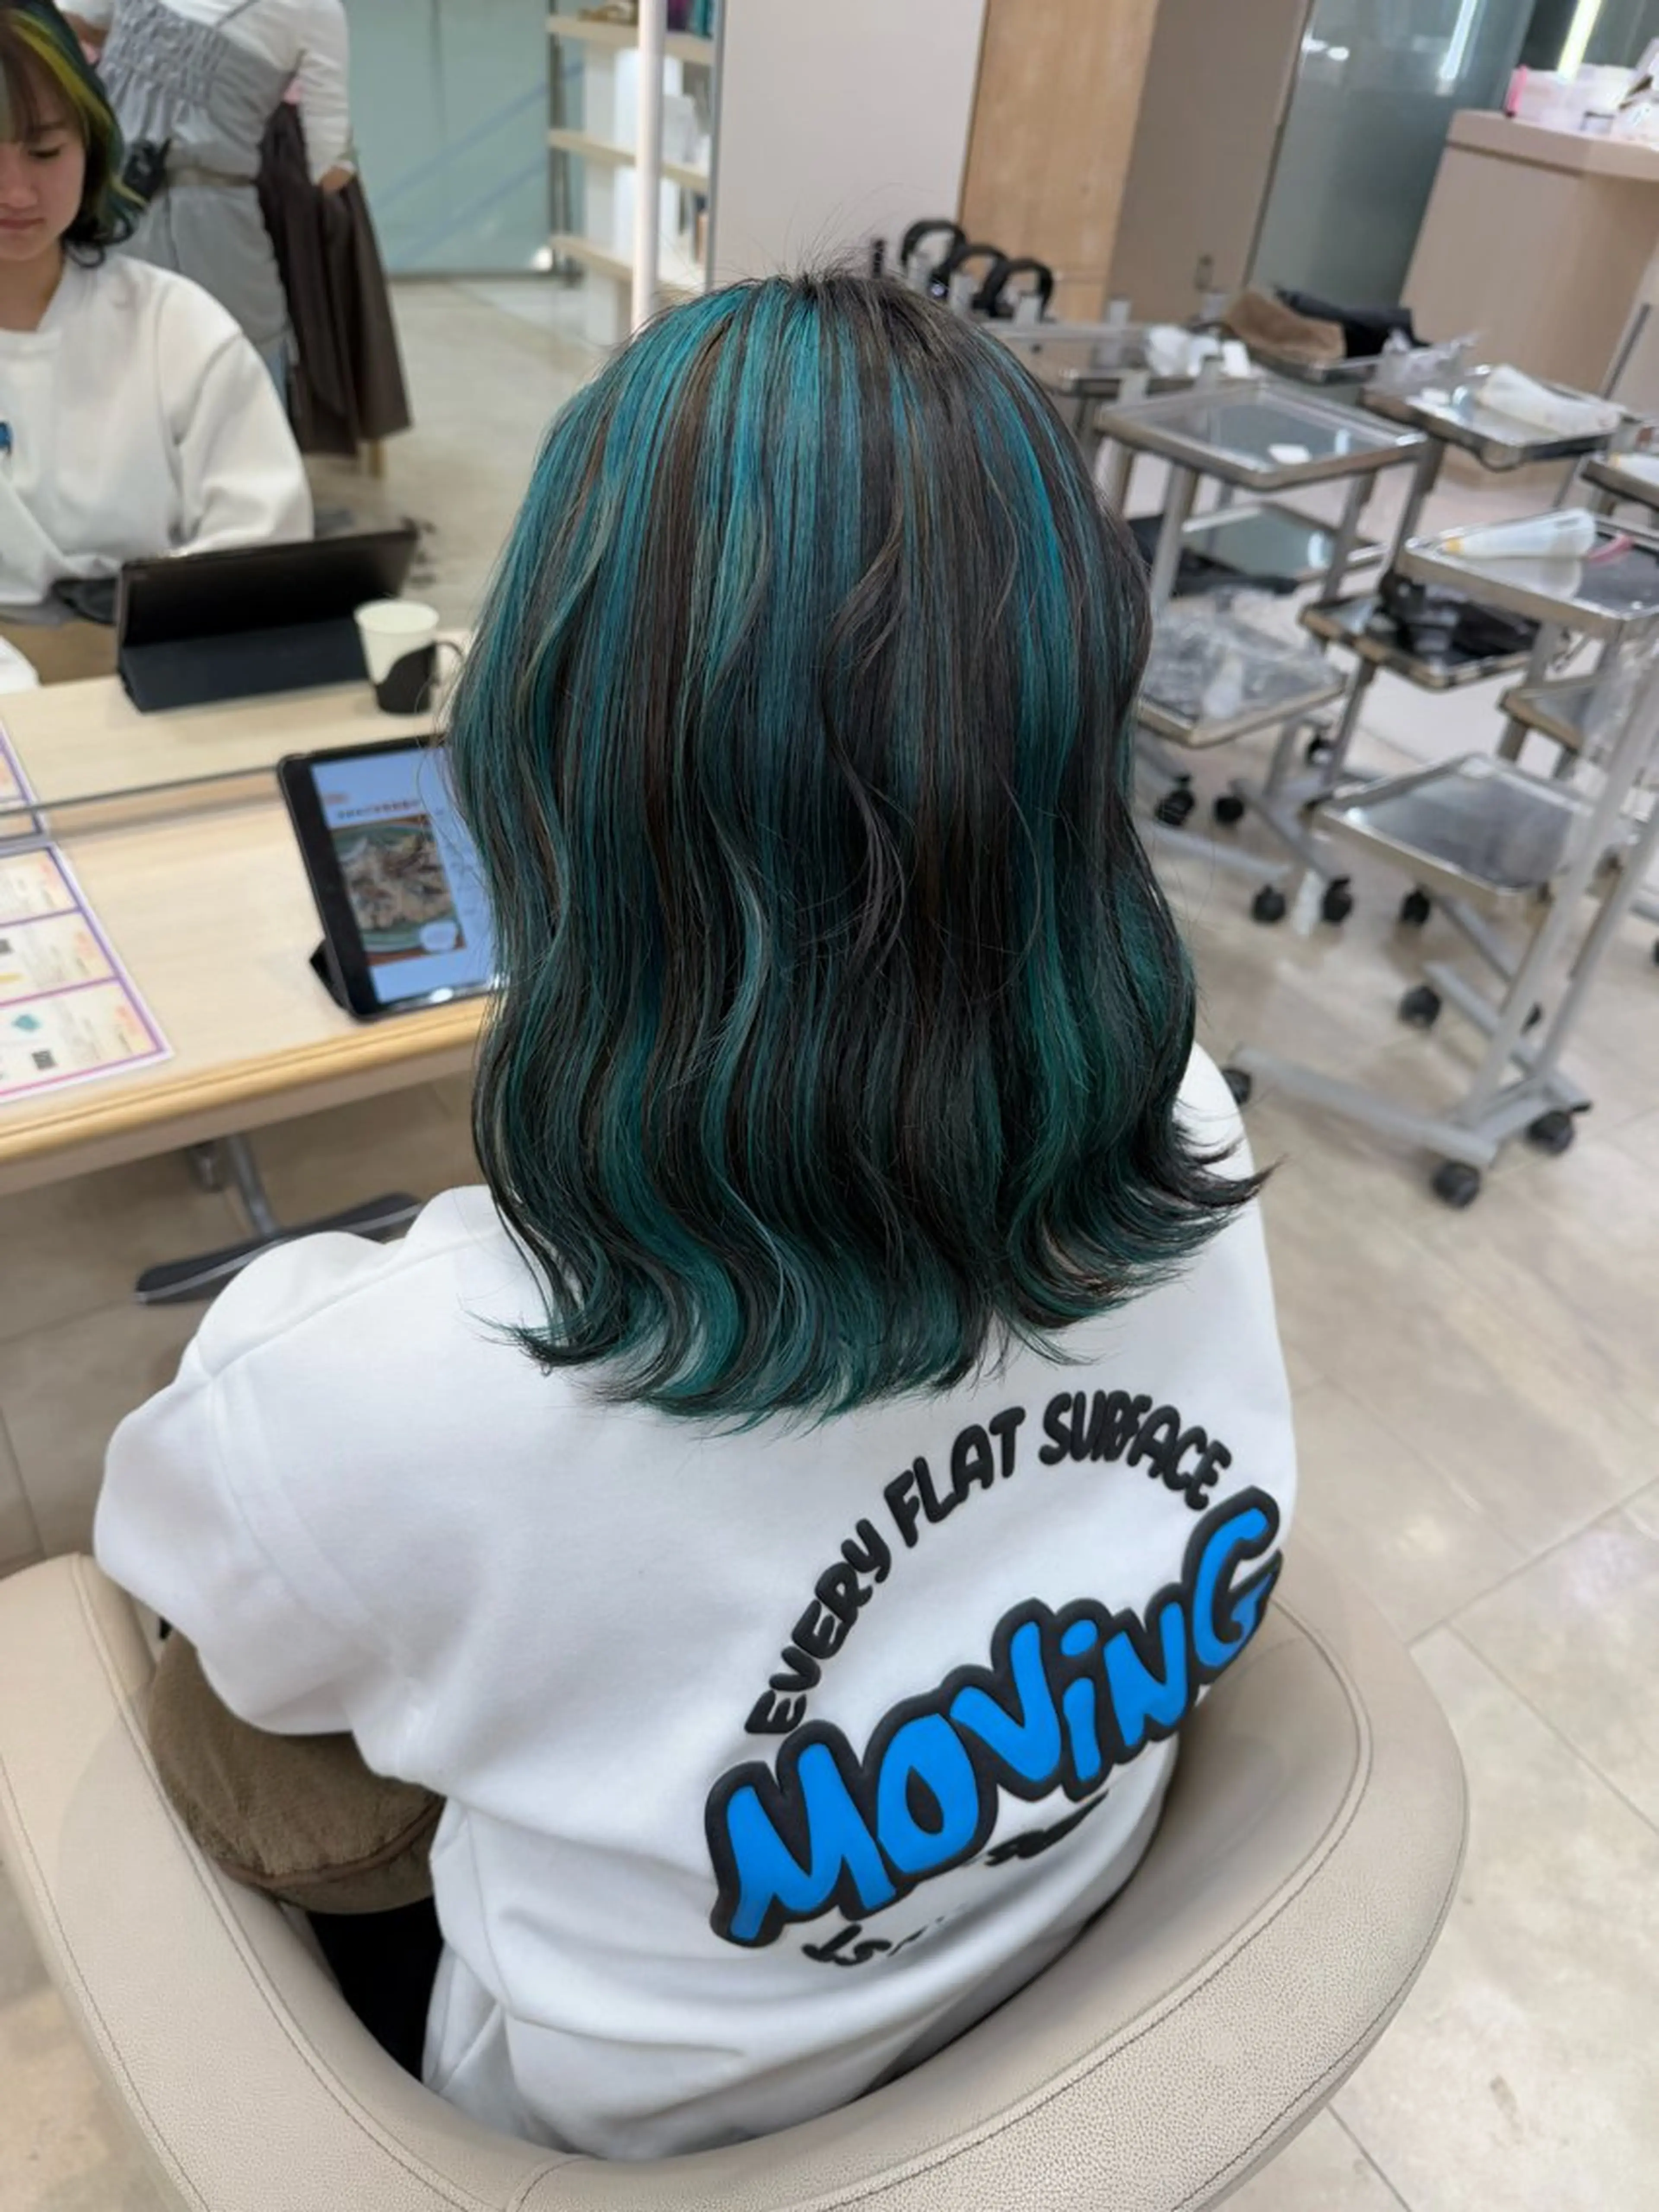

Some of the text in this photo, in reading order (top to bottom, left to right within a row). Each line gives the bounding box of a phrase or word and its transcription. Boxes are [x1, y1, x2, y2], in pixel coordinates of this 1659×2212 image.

[745, 1390, 1232, 1735] EVERY FLAT SURFACE
